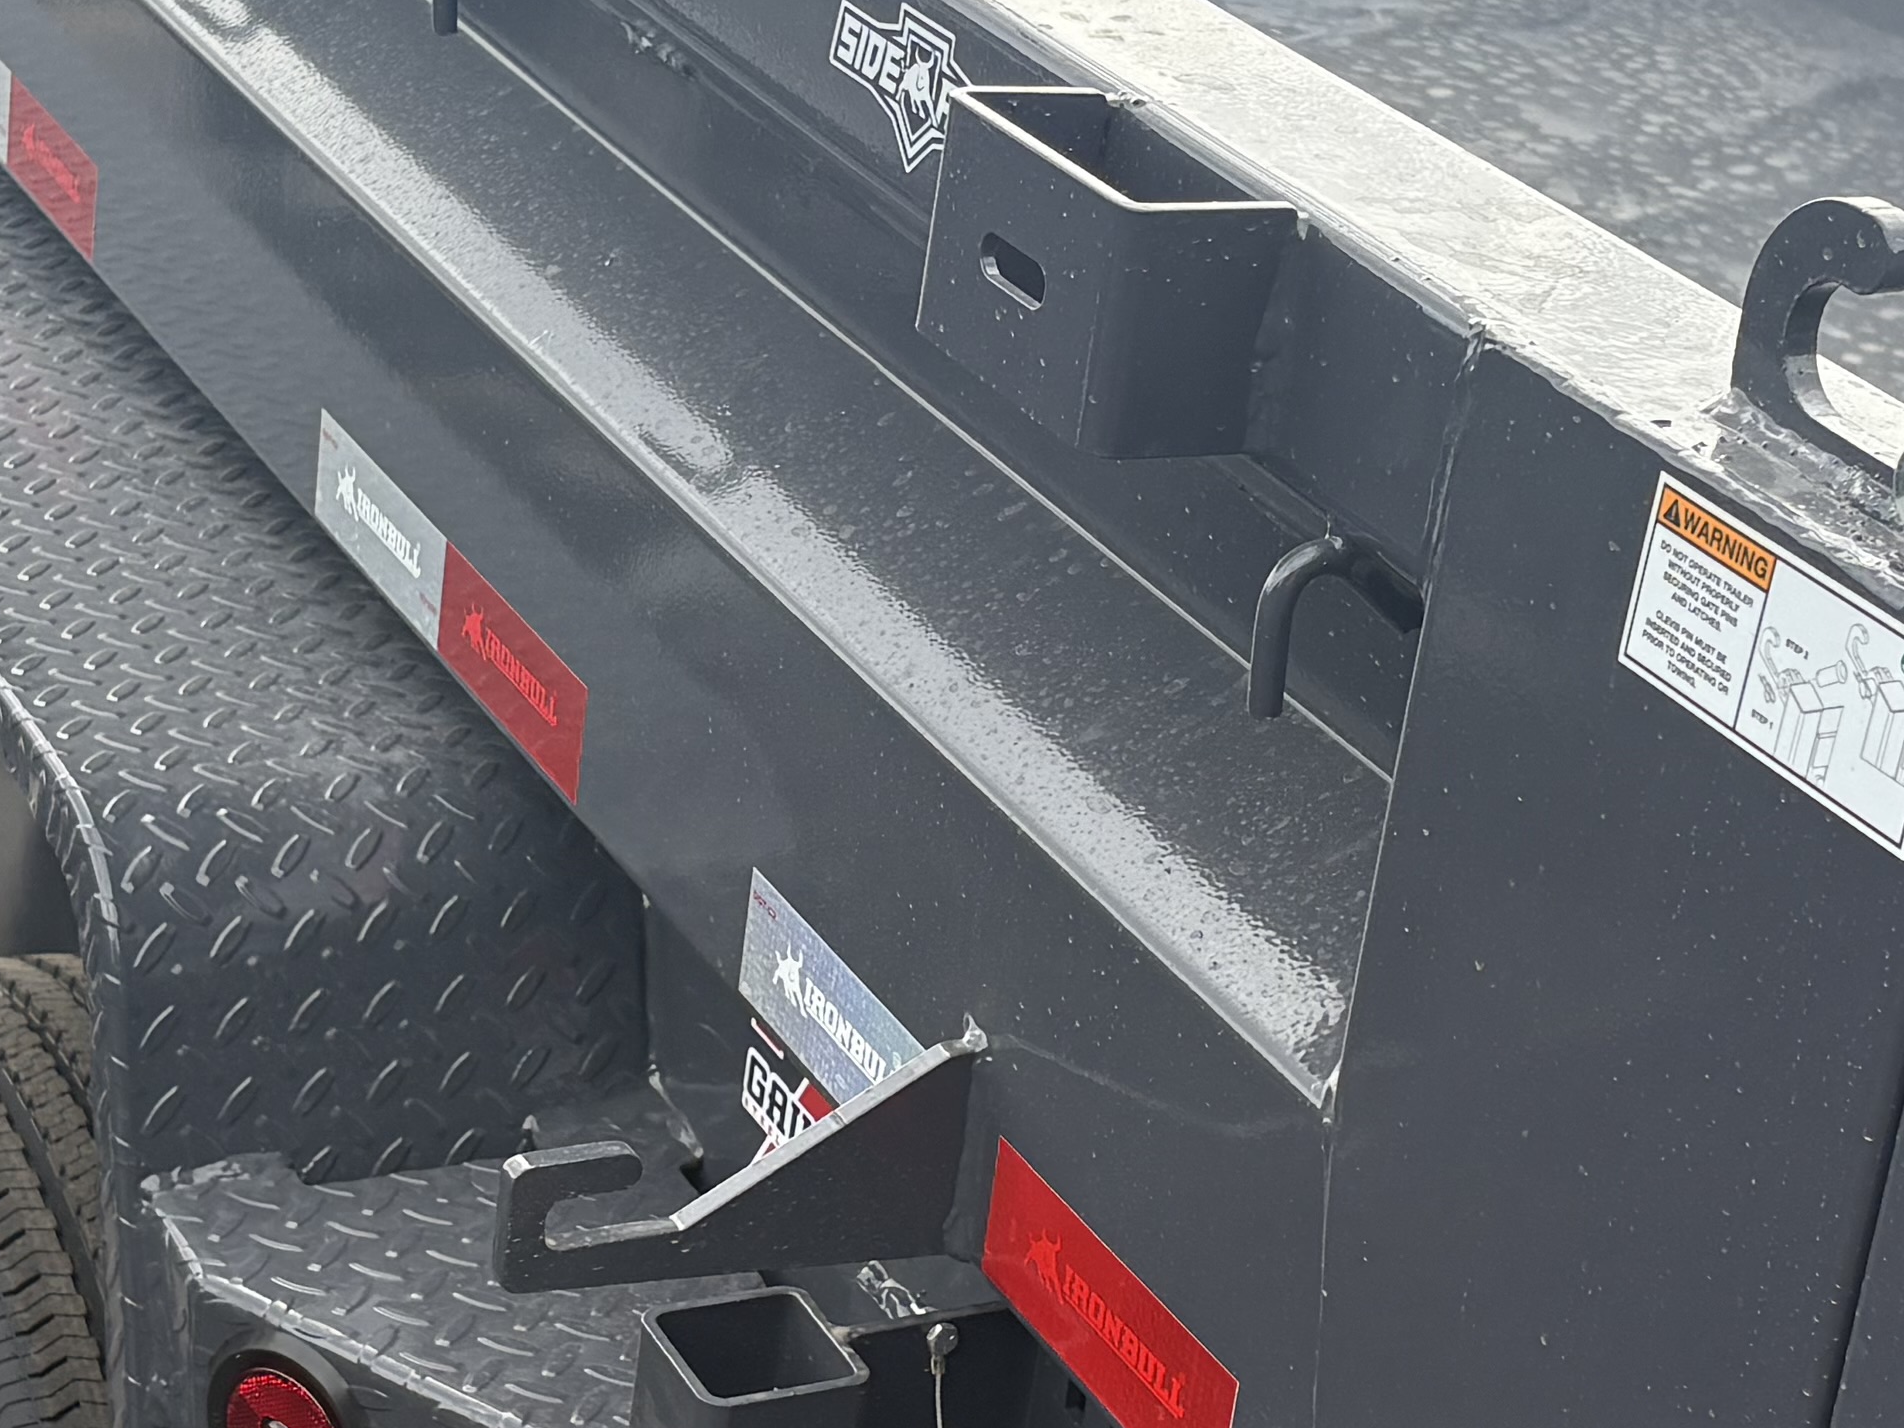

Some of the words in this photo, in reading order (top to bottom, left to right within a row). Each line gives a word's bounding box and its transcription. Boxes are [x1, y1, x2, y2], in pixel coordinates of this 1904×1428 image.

[836, 12, 905, 95] SIDE
[357, 488, 421, 578] IRONBULL
[1684, 507, 1769, 581] WARNING
[1661, 540, 1672, 553] DO
[1673, 548, 1688, 563] NOT
[1689, 559, 1722, 587] OPERATE
[1723, 581, 1754, 608] TRAILER
[1663, 571, 1699, 602] SECURING
[1700, 596, 1720, 615] GATE
[1720, 610, 1738, 627] PINS
[1668, 559, 1701, 586] WITHOUT
[1701, 582, 1740, 612] PROPERLY
[1671, 592, 1687, 608] AND
[484, 628, 558, 727] IRONBULL
[1642, 629, 1664, 650] PRIOR
[1665, 644, 1675, 657] TO
[1676, 653, 1716, 687] OPERATING
[1717, 681, 1728, 696] OR
[1680, 642, 1696, 657] AND
[1696, 653, 1732, 682] SECURED
[1694, 636, 1716, 655] MUST
[1063, 1265, 1185, 1419] IRONBULL
